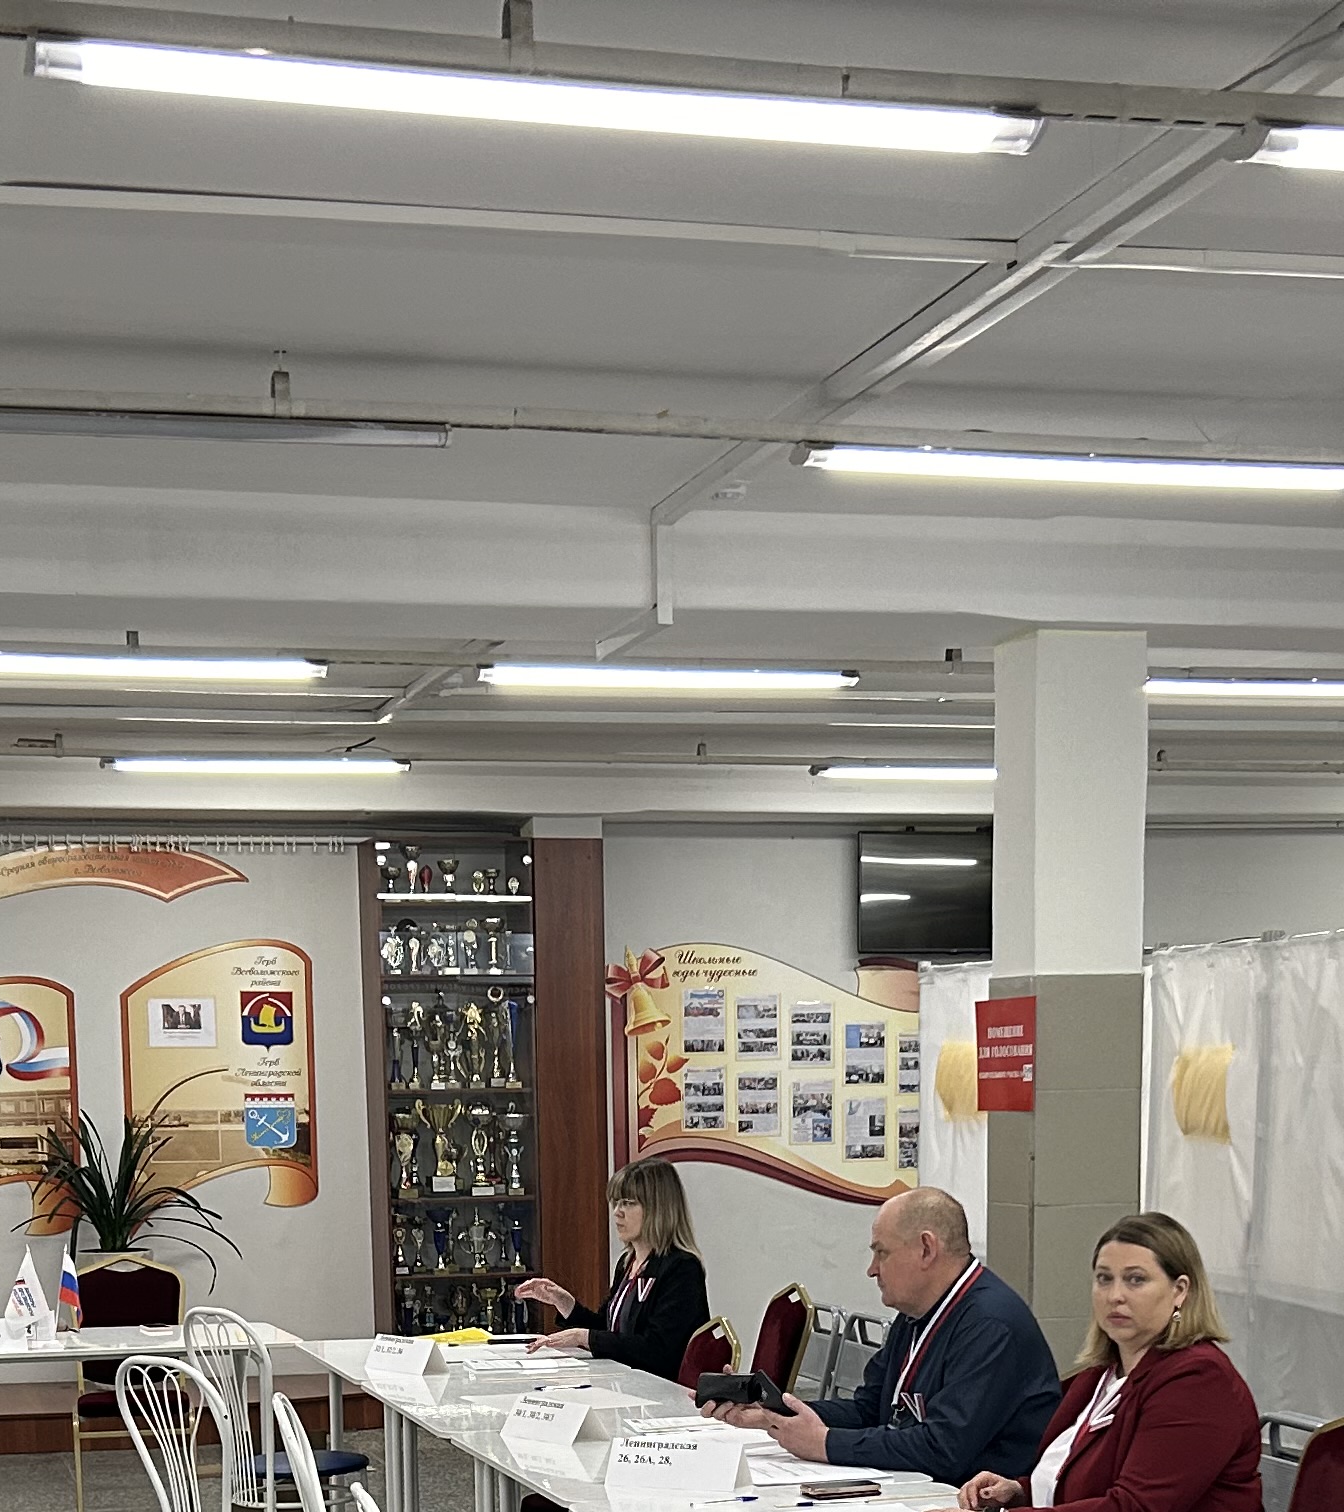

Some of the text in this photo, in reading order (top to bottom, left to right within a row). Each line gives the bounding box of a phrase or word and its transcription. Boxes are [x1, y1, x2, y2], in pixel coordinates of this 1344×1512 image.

[254, 955, 277, 967] Герб
[675, 949, 742, 965] Школьные
[701, 968, 758, 983] чудесные
[257, 1057, 280, 1068] Герб
[620, 1438, 698, 1451] Ленинградская
[617, 1453, 632, 1464] 26,
[658, 1455, 673, 1466] 28,
